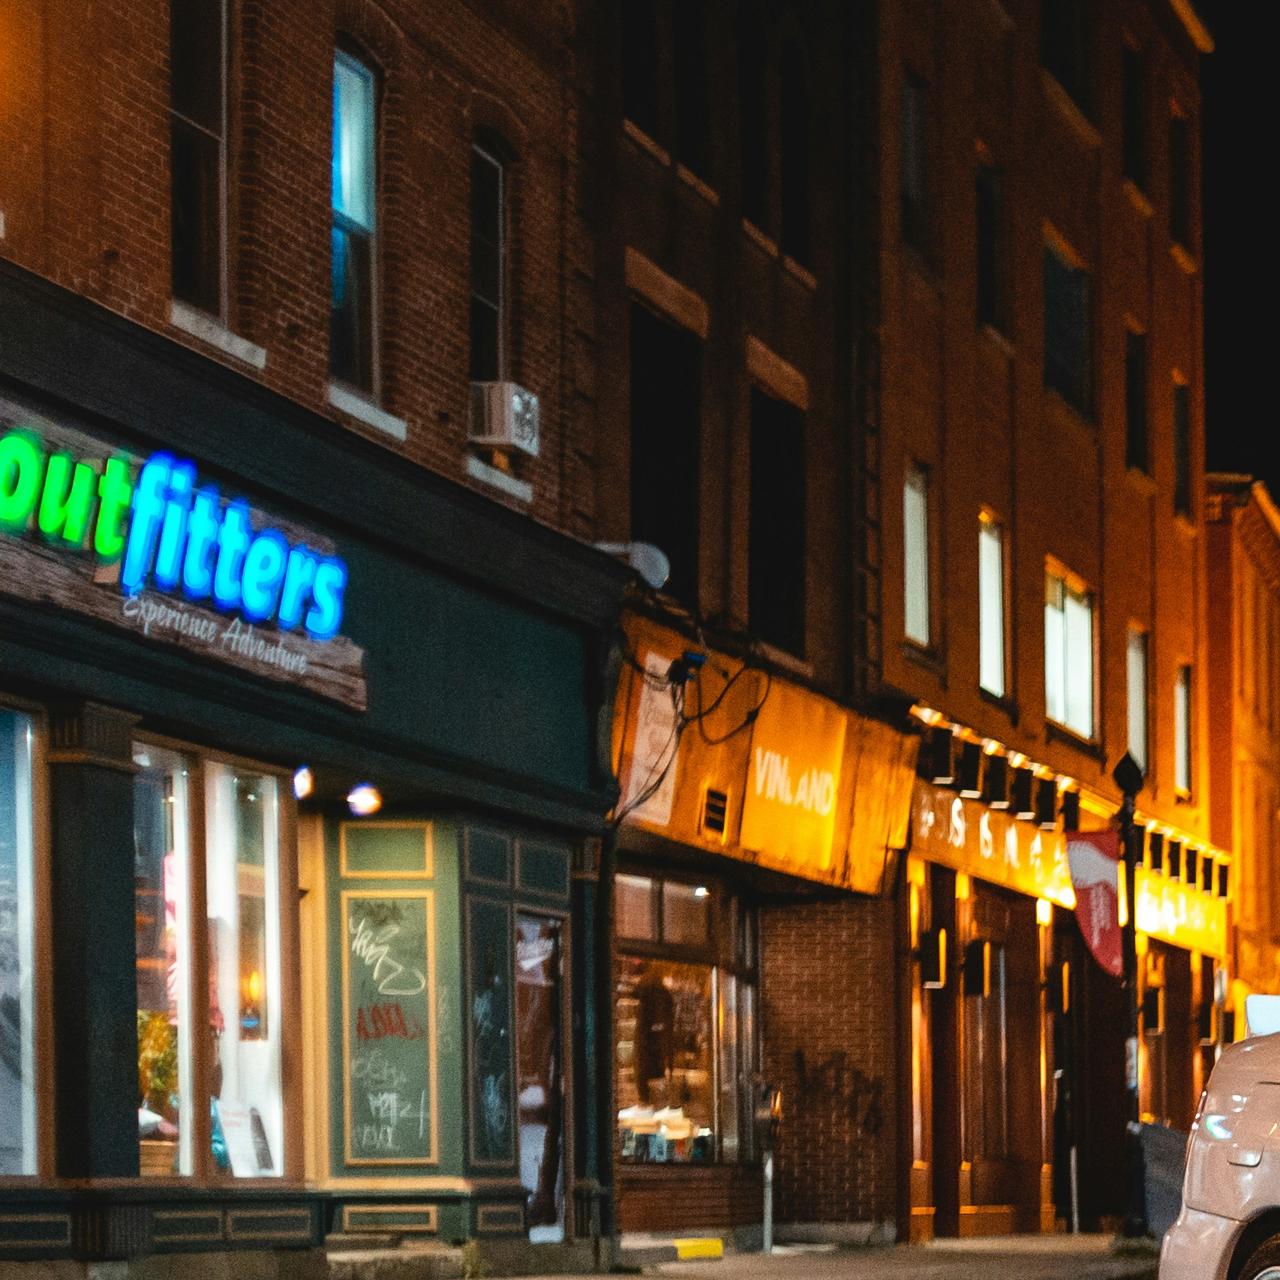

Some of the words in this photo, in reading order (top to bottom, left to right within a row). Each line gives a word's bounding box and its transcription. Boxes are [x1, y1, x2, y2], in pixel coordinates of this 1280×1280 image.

[0, 434, 346, 638] outfitters
[123, 594, 217, 643] Experience
[223, 617, 308, 674] Adventure
